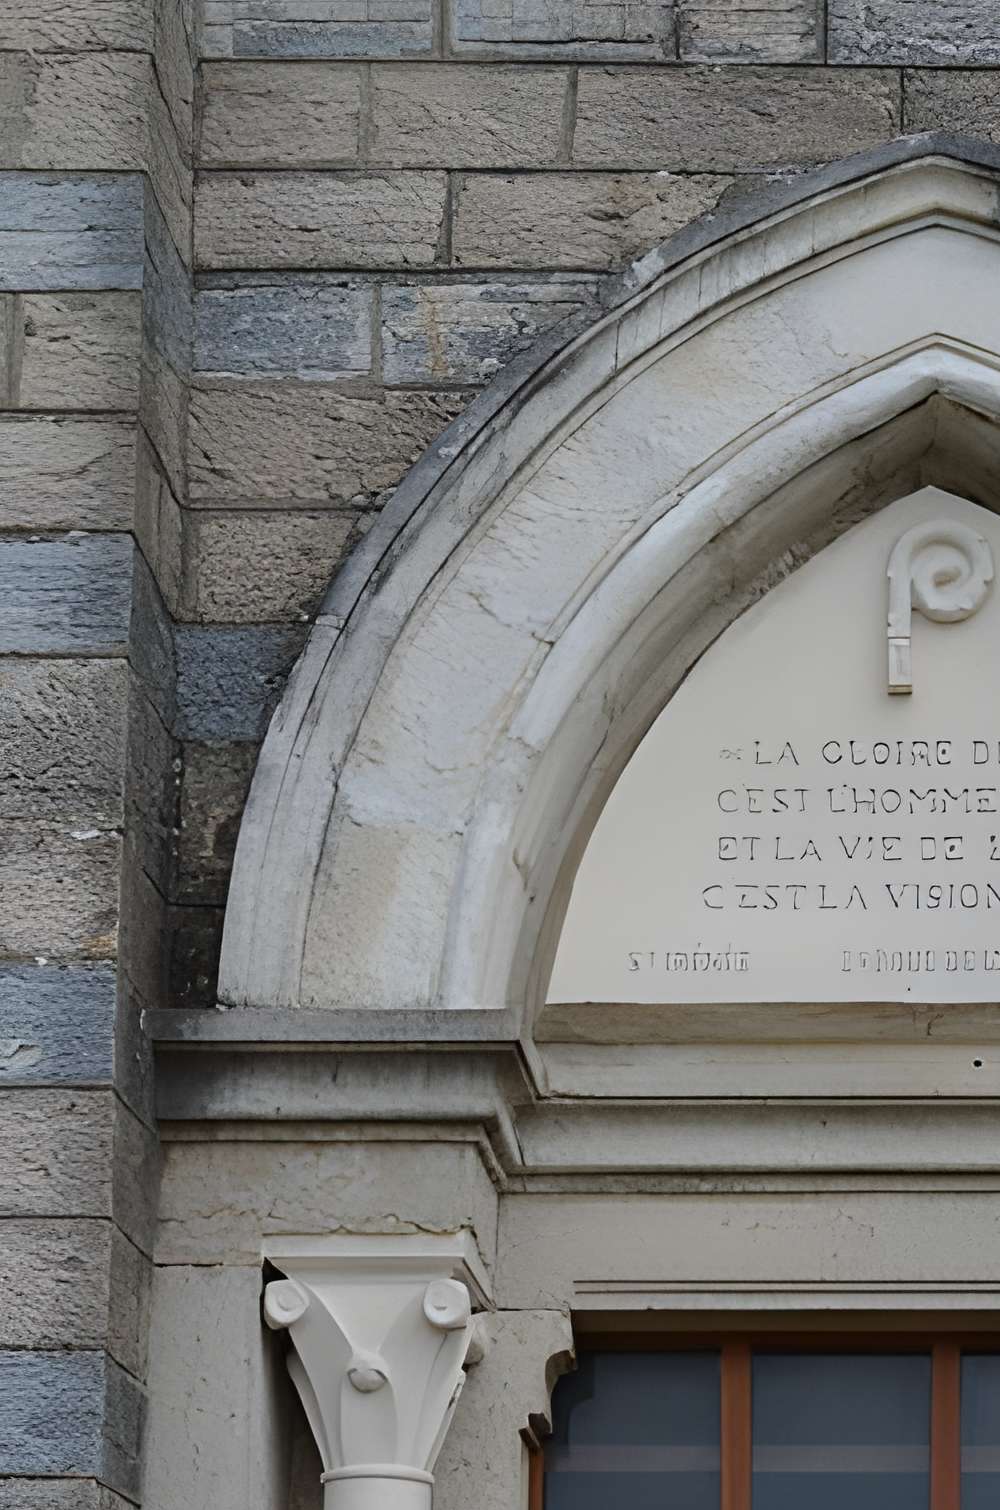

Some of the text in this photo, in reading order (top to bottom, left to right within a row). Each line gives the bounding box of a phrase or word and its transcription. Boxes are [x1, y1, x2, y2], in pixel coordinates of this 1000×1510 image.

[827, 784, 997, 814] L'HOMME
[718, 836, 761, 861] ET
[775, 836, 822, 861] LA
[838, 836, 902, 861] VIE
[920, 836, 964, 860] DE
[818, 884, 867, 910] LA
